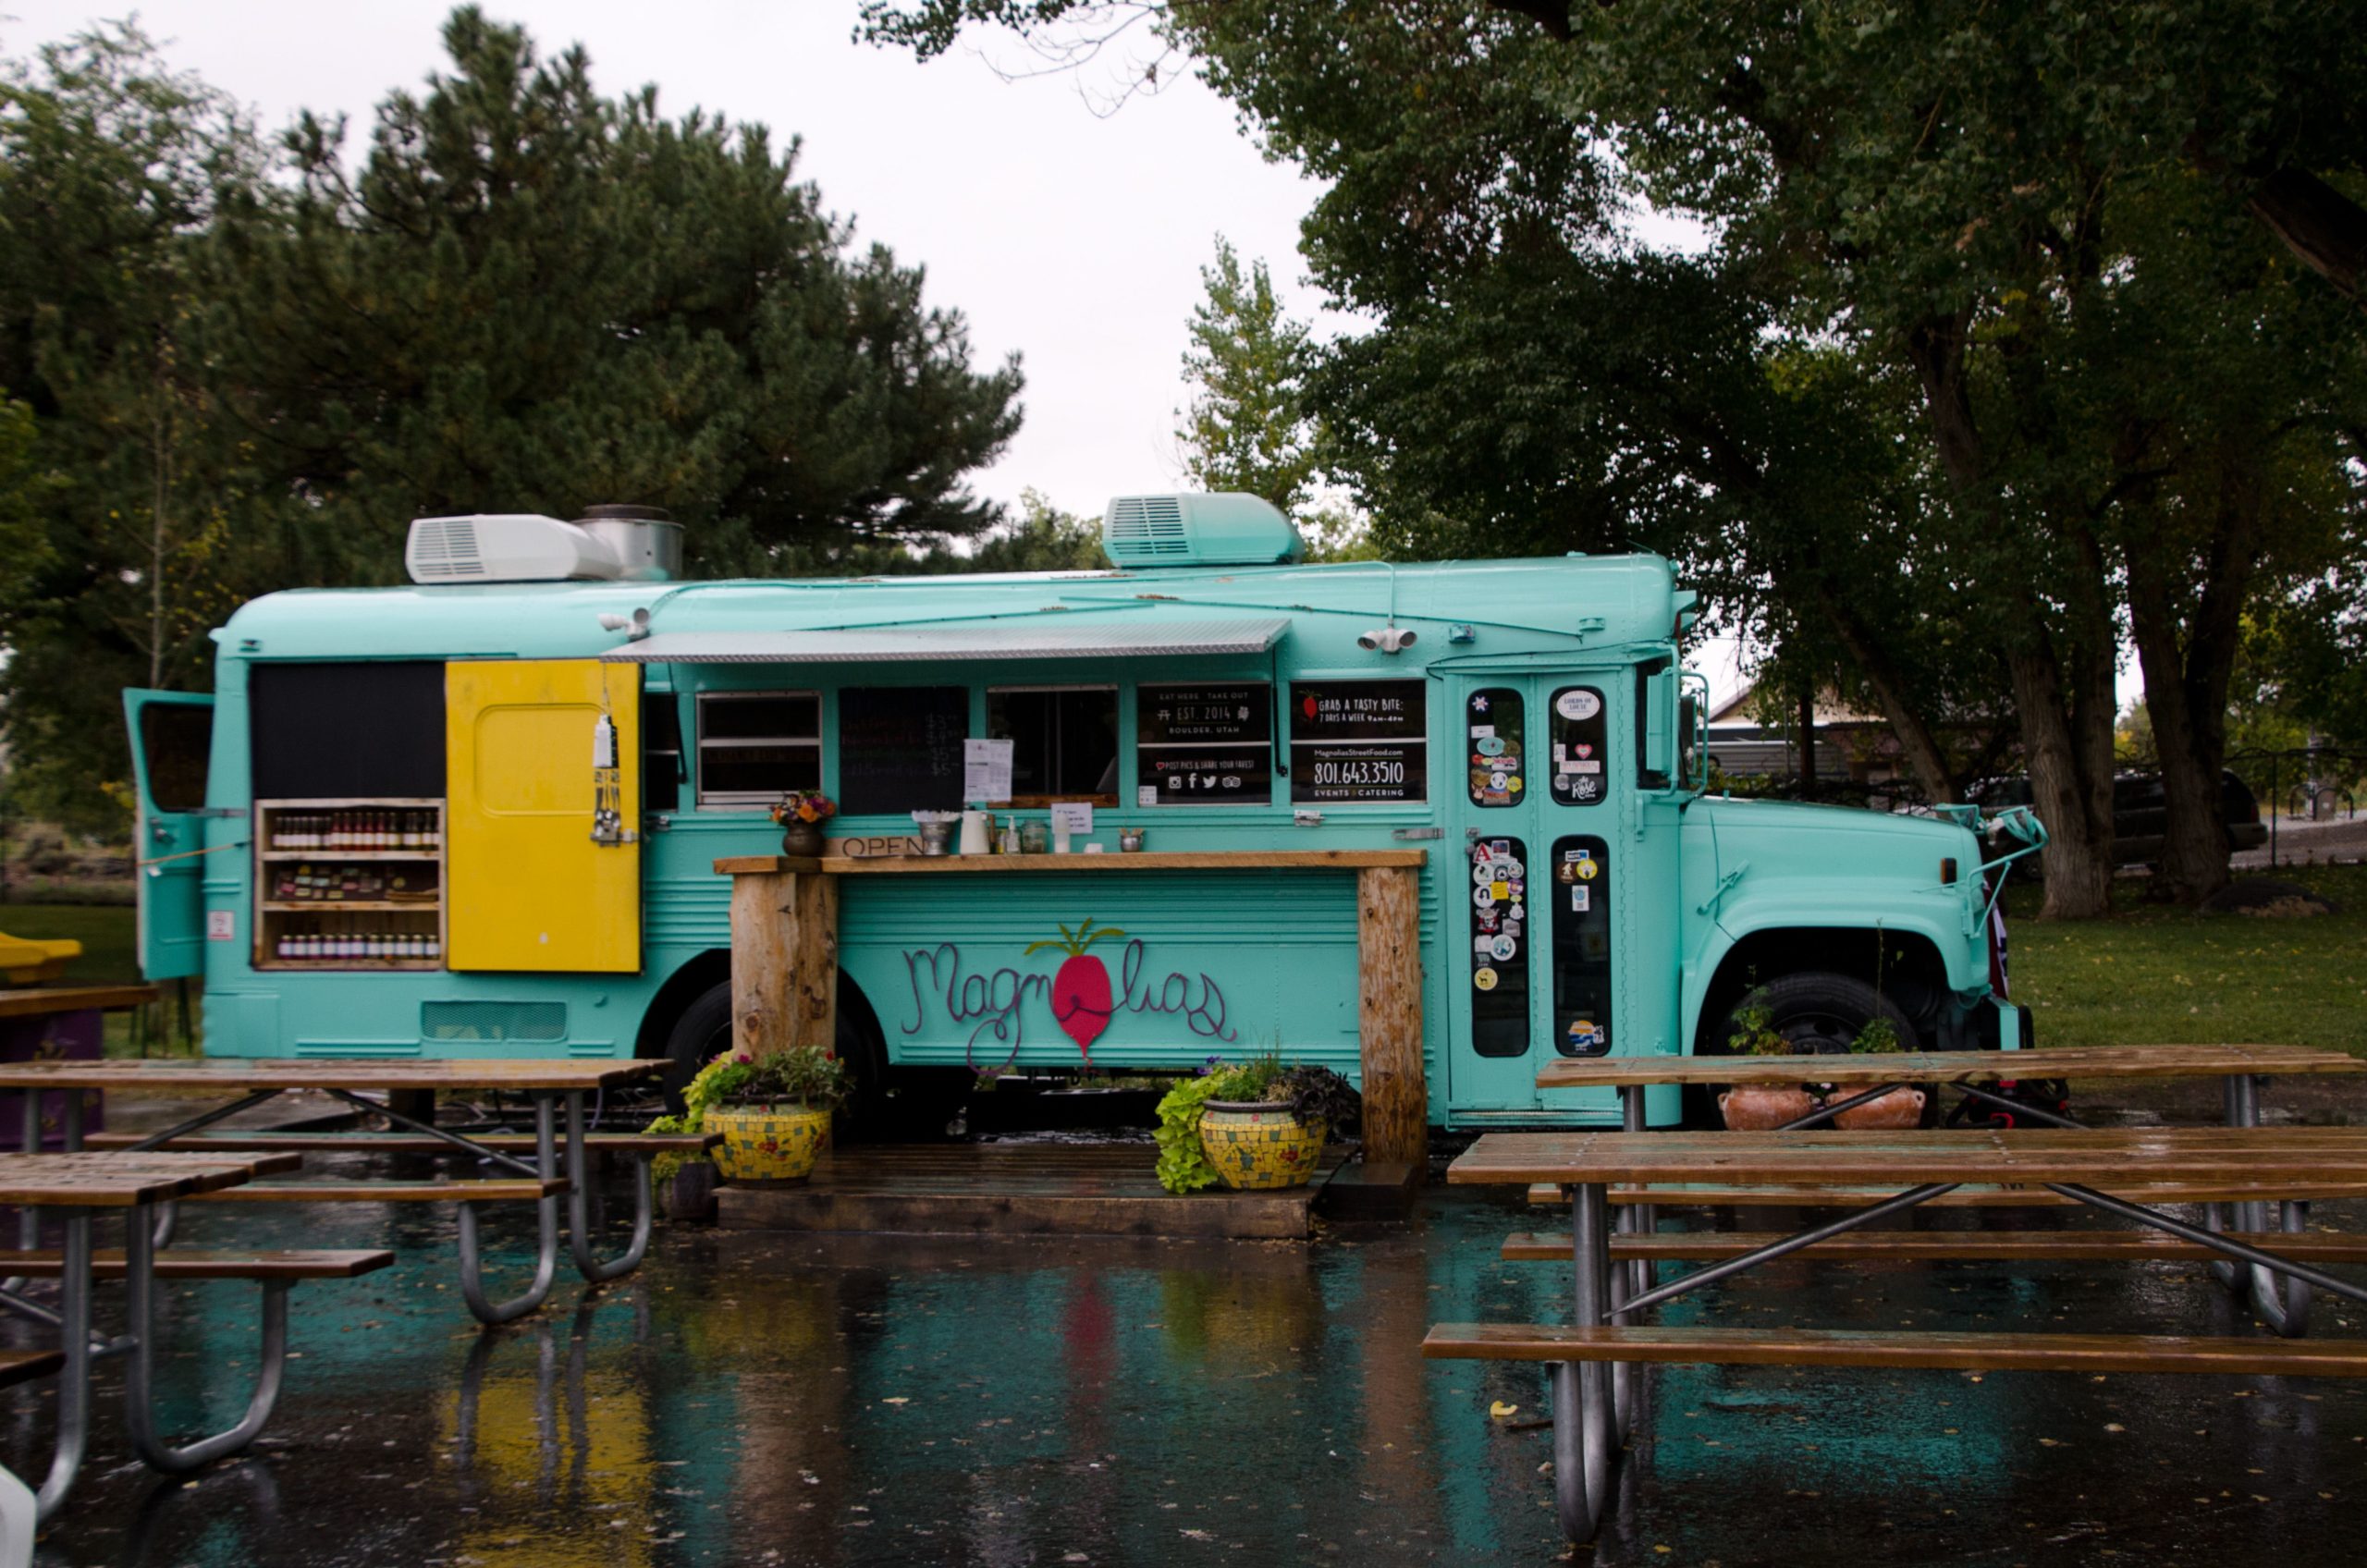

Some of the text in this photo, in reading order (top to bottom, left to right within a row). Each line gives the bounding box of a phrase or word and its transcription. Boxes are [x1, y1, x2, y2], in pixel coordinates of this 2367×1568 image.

[1177, 705, 1231, 719] EST. 2014
[1318, 698, 1404, 712] GRAB A TASTY BITE:
[1325, 714, 1340, 722] DAYS
[1348, 713, 1366, 721] WEEK
[1314, 748, 1404, 758] MagnoliasStreetFood.com
[1165, 761, 1180, 770] POST
[1180, 761, 1193, 769] PICS
[1200, 760, 1218, 769] SHARE
[1219, 760, 1234, 769] YOUR
[1314, 761, 1404, 785] 801.643.3510
[1314, 789, 1349, 797] EVENTS
[1357, 789, 1404, 797] CATERING
[1572, 780, 1597, 800] Rose
[841, 836, 926, 858] OPEN
[901, 938, 1238, 1075] Magnolias
